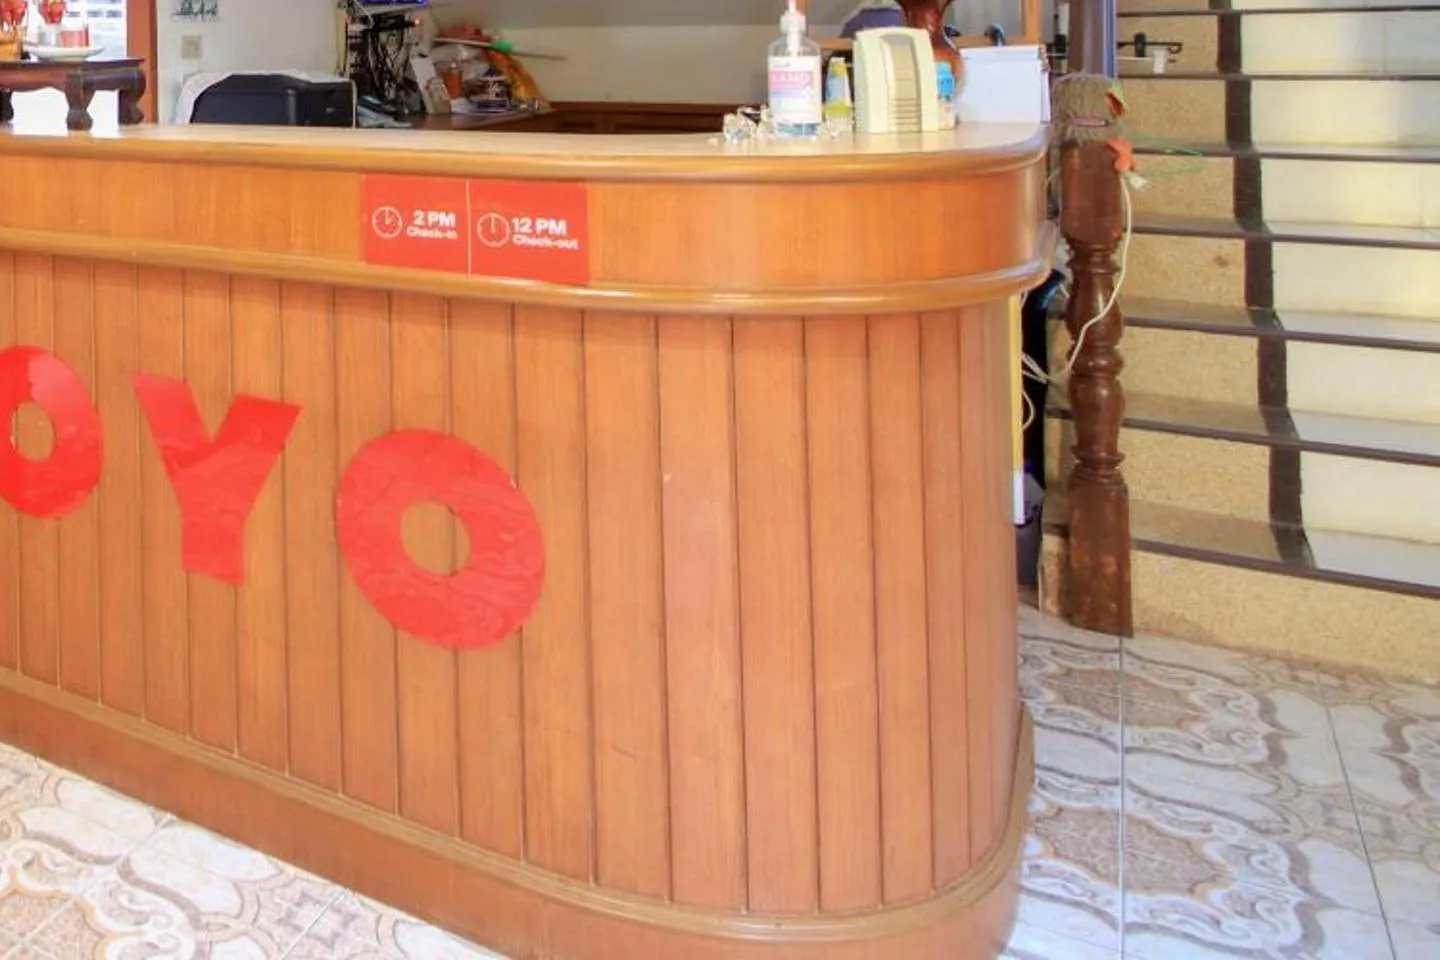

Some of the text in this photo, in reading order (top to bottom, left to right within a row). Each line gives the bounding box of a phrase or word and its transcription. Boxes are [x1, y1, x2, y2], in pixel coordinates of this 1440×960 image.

[413, 209, 456, 228] 2 PM
[512, 217, 567, 236] 12 PM
